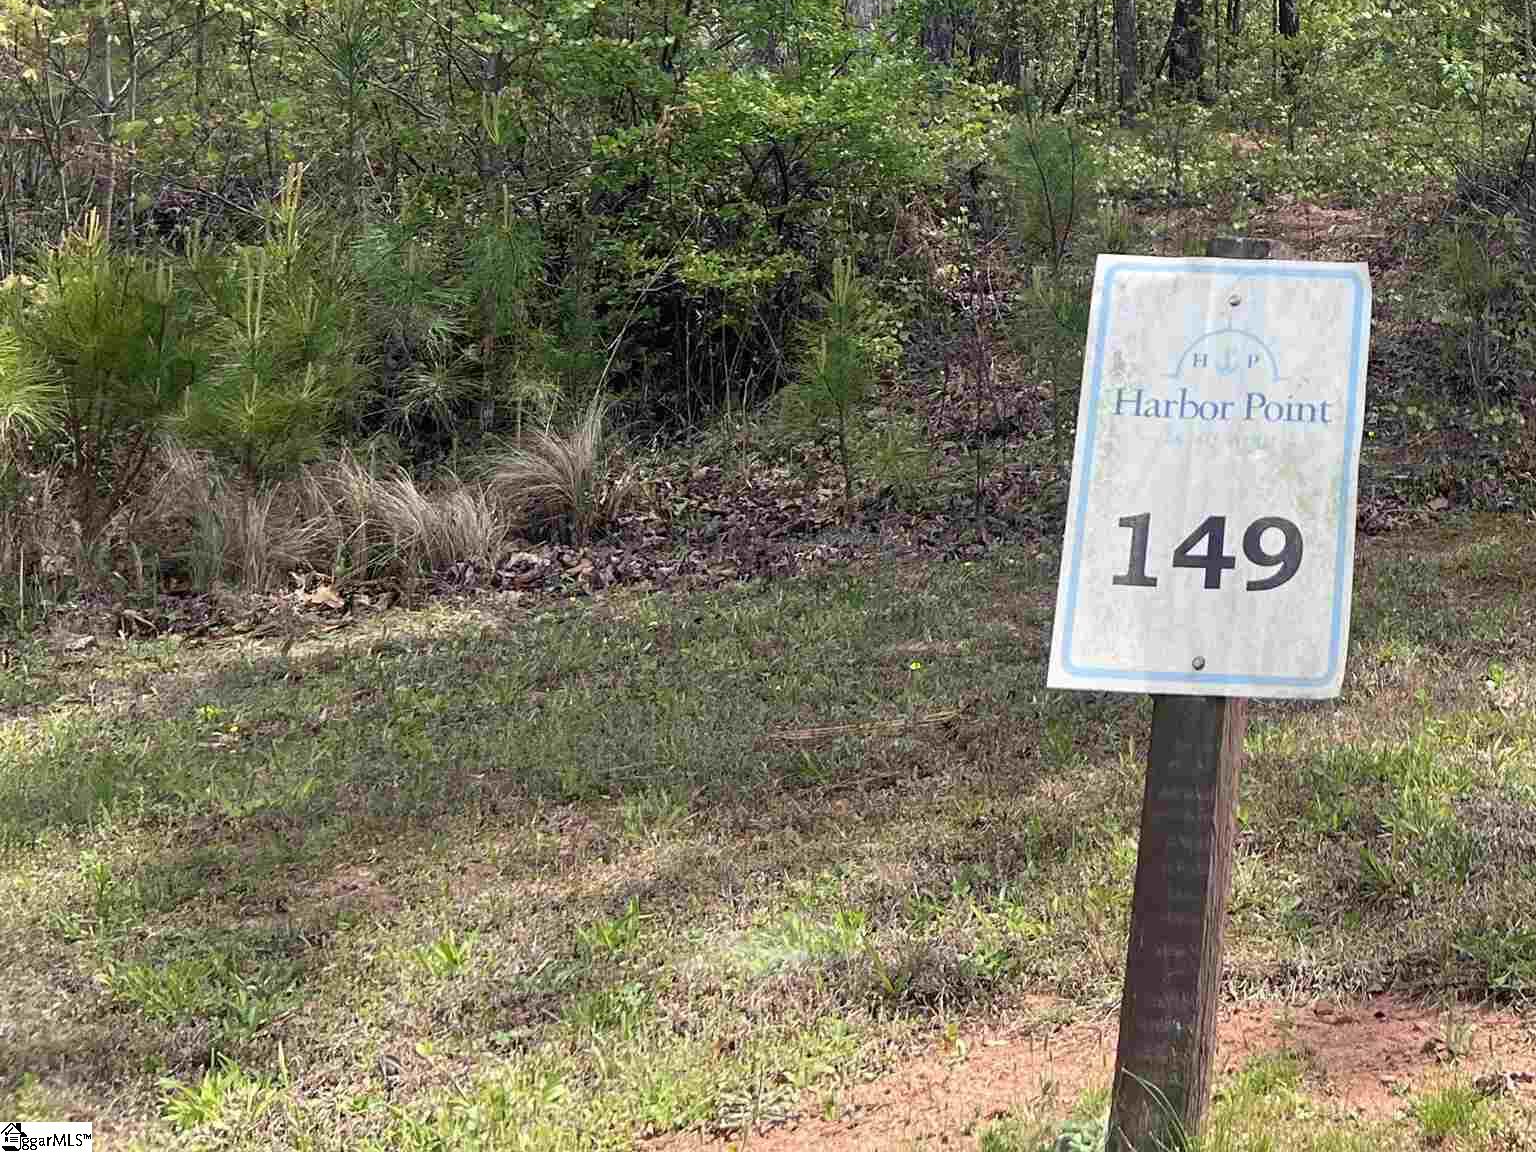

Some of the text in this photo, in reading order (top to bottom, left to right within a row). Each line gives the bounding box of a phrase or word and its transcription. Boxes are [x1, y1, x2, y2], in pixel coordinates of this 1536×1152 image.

[1193, 352, 1260, 370] H P
[1113, 387, 1332, 425] Harbor Point
[1112, 512, 1304, 592] 149
